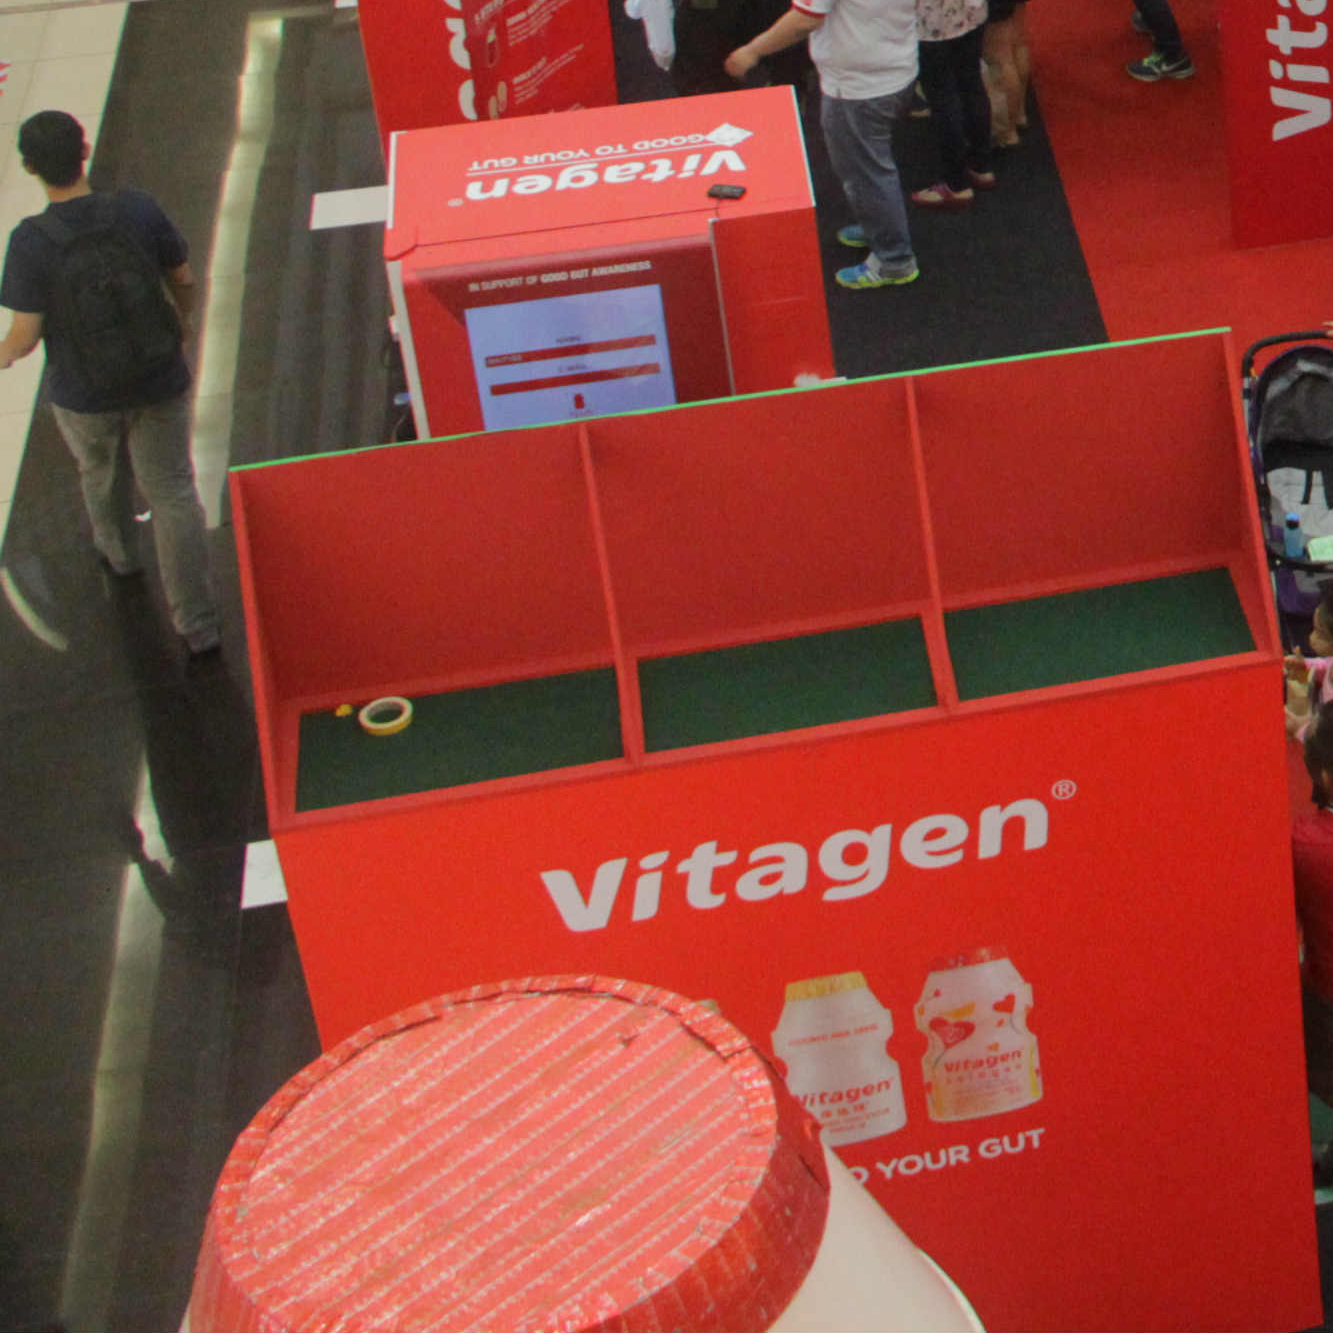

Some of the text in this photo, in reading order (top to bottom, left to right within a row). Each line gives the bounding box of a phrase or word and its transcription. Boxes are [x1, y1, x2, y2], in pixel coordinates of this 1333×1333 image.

[467, 155, 518, 173] GUT
[523, 147, 590, 167] YOUR
[596, 143, 627, 159] TO
[465, 150, 747, 202] Vitagen
[481, 277, 523, 290] SUPPORT
[540, 271, 568, 284] GOOD
[571, 269, 589, 279] GUT
[592, 260, 652, 277] AWARENESS
[540, 797, 1049, 933] Vitagen
[943, 1049, 1023, 1074] Vitagen
[876, 1128, 1046, 1180] YOUR GUT
